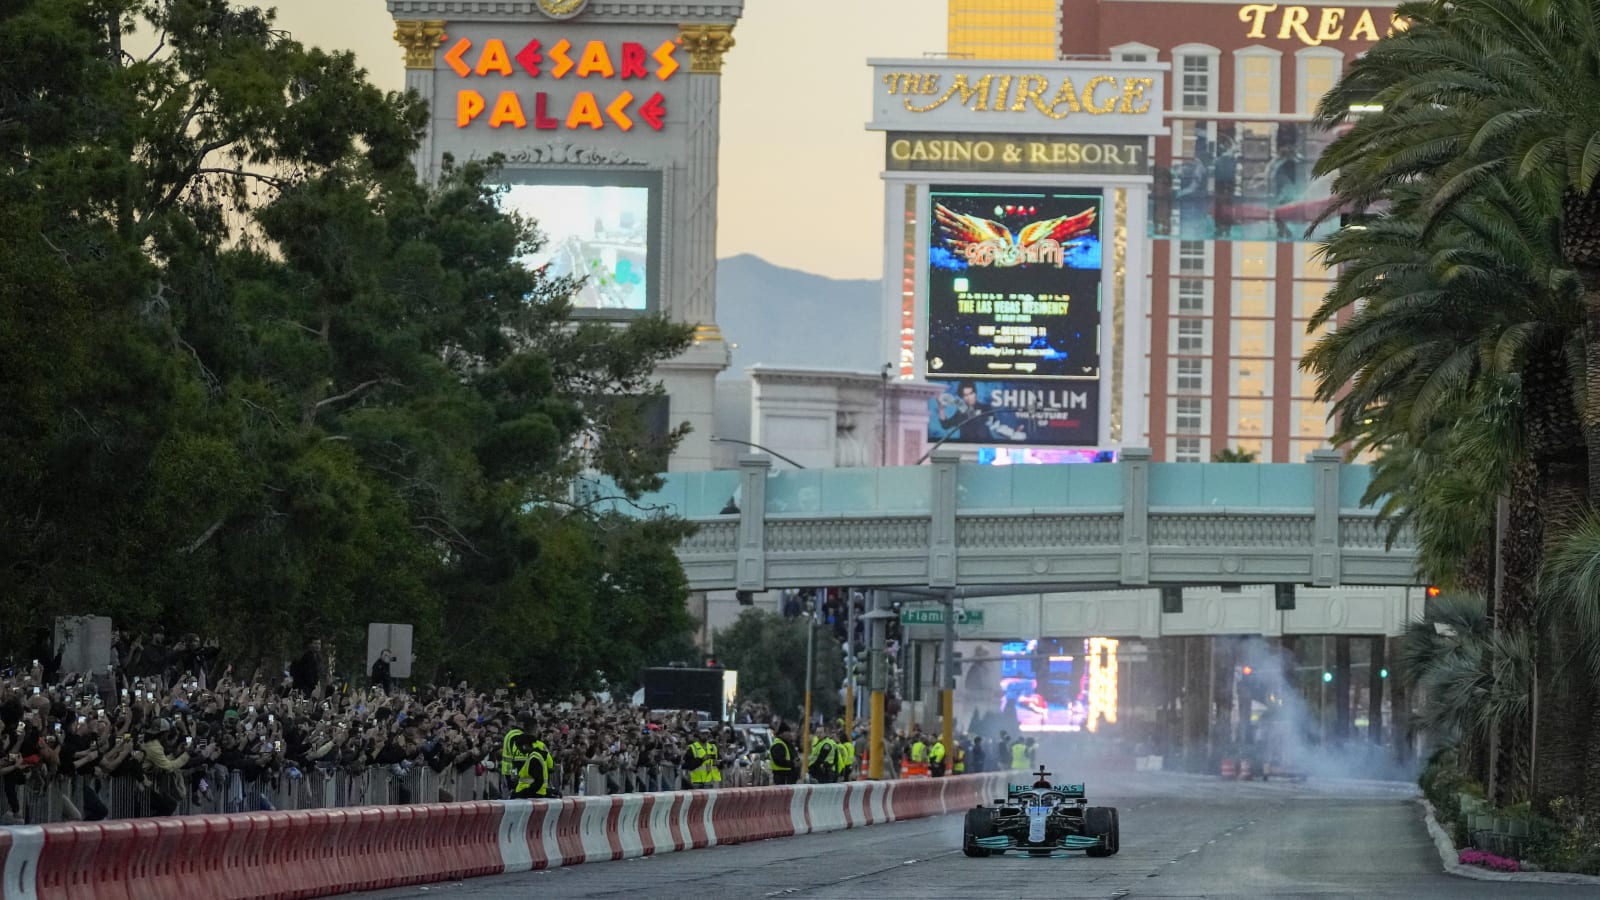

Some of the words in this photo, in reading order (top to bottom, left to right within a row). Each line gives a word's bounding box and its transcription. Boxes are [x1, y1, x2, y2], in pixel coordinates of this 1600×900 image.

[444, 38, 680, 81] CAESARS
[882, 72, 941, 95] THE
[904, 73, 1153, 120] MIRAGE
[457, 90, 666, 131] PALACE
[891, 140, 994, 162] CASINO
[1002, 143, 1022, 163] &
[1030, 142, 1142, 165] RESORT
[958, 300, 975, 313] THE
[976, 301, 992, 314] LAS
[994, 301, 1021, 314] VEGAS
[991, 389, 1044, 409] SHIN
[1049, 390, 1088, 409] LIM
[908, 609, 967, 625] Flamigo
